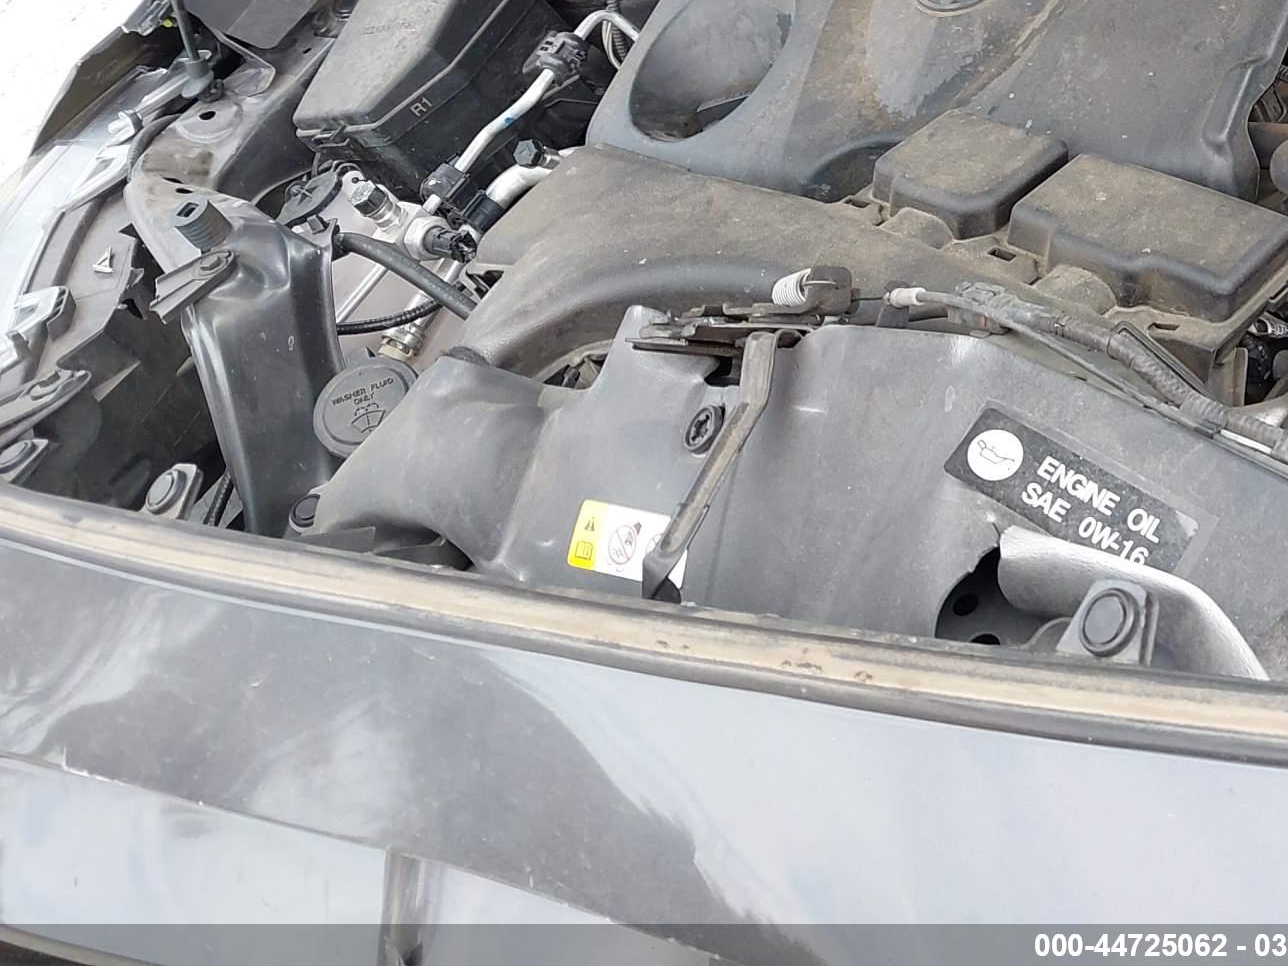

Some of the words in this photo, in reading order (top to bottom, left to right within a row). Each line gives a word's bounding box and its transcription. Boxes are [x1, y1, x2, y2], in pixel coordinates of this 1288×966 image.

[411, 97, 433, 117] R1
[370, 377, 394, 392] FLUID
[1020, 482, 1072, 522] SAE
[1077, 516, 1150, 566] 0W-16
[1036, 455, 1120, 515] ENGINE
[1127, 508, 1162, 543] OIL
